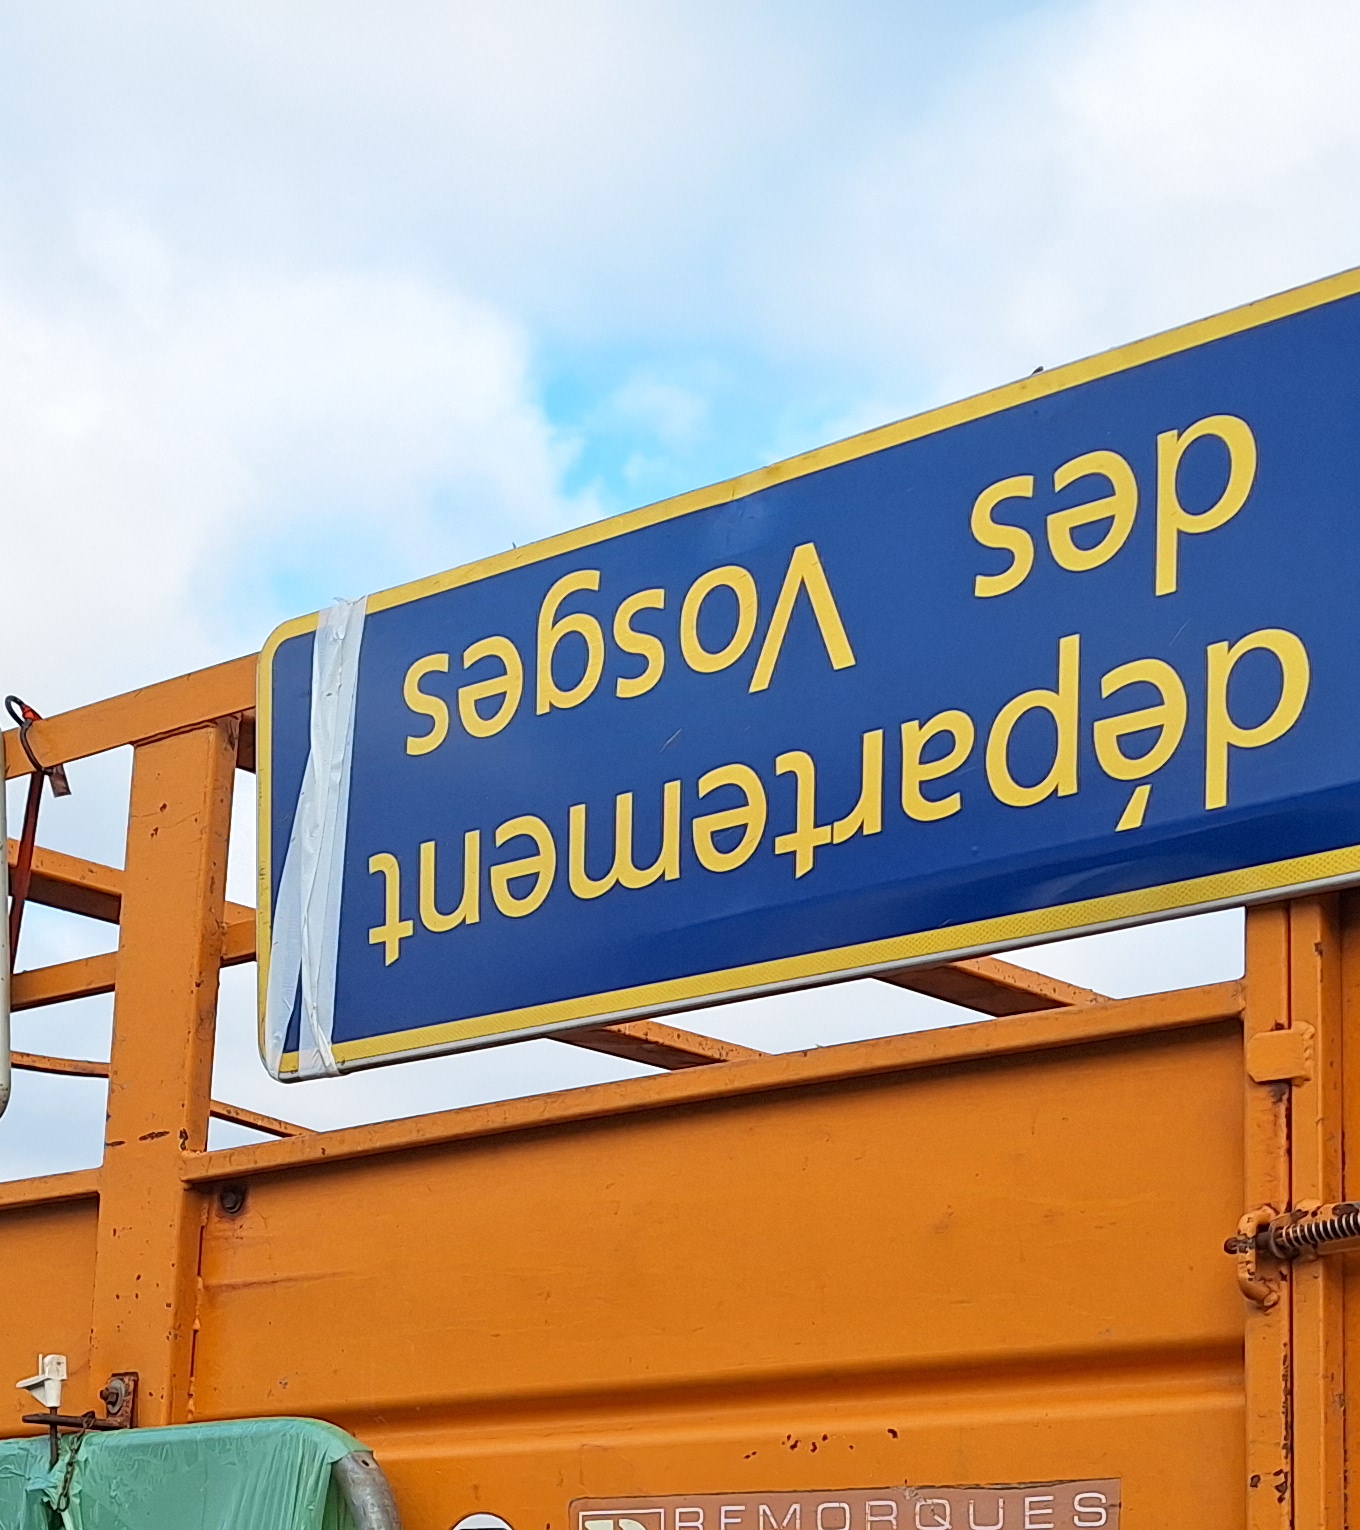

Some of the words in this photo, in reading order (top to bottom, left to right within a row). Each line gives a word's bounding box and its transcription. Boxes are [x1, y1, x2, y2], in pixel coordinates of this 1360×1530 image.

[969, 414, 1258, 597] des
[402, 541, 857, 757] Vosges
[367, 627, 1309, 968] département
